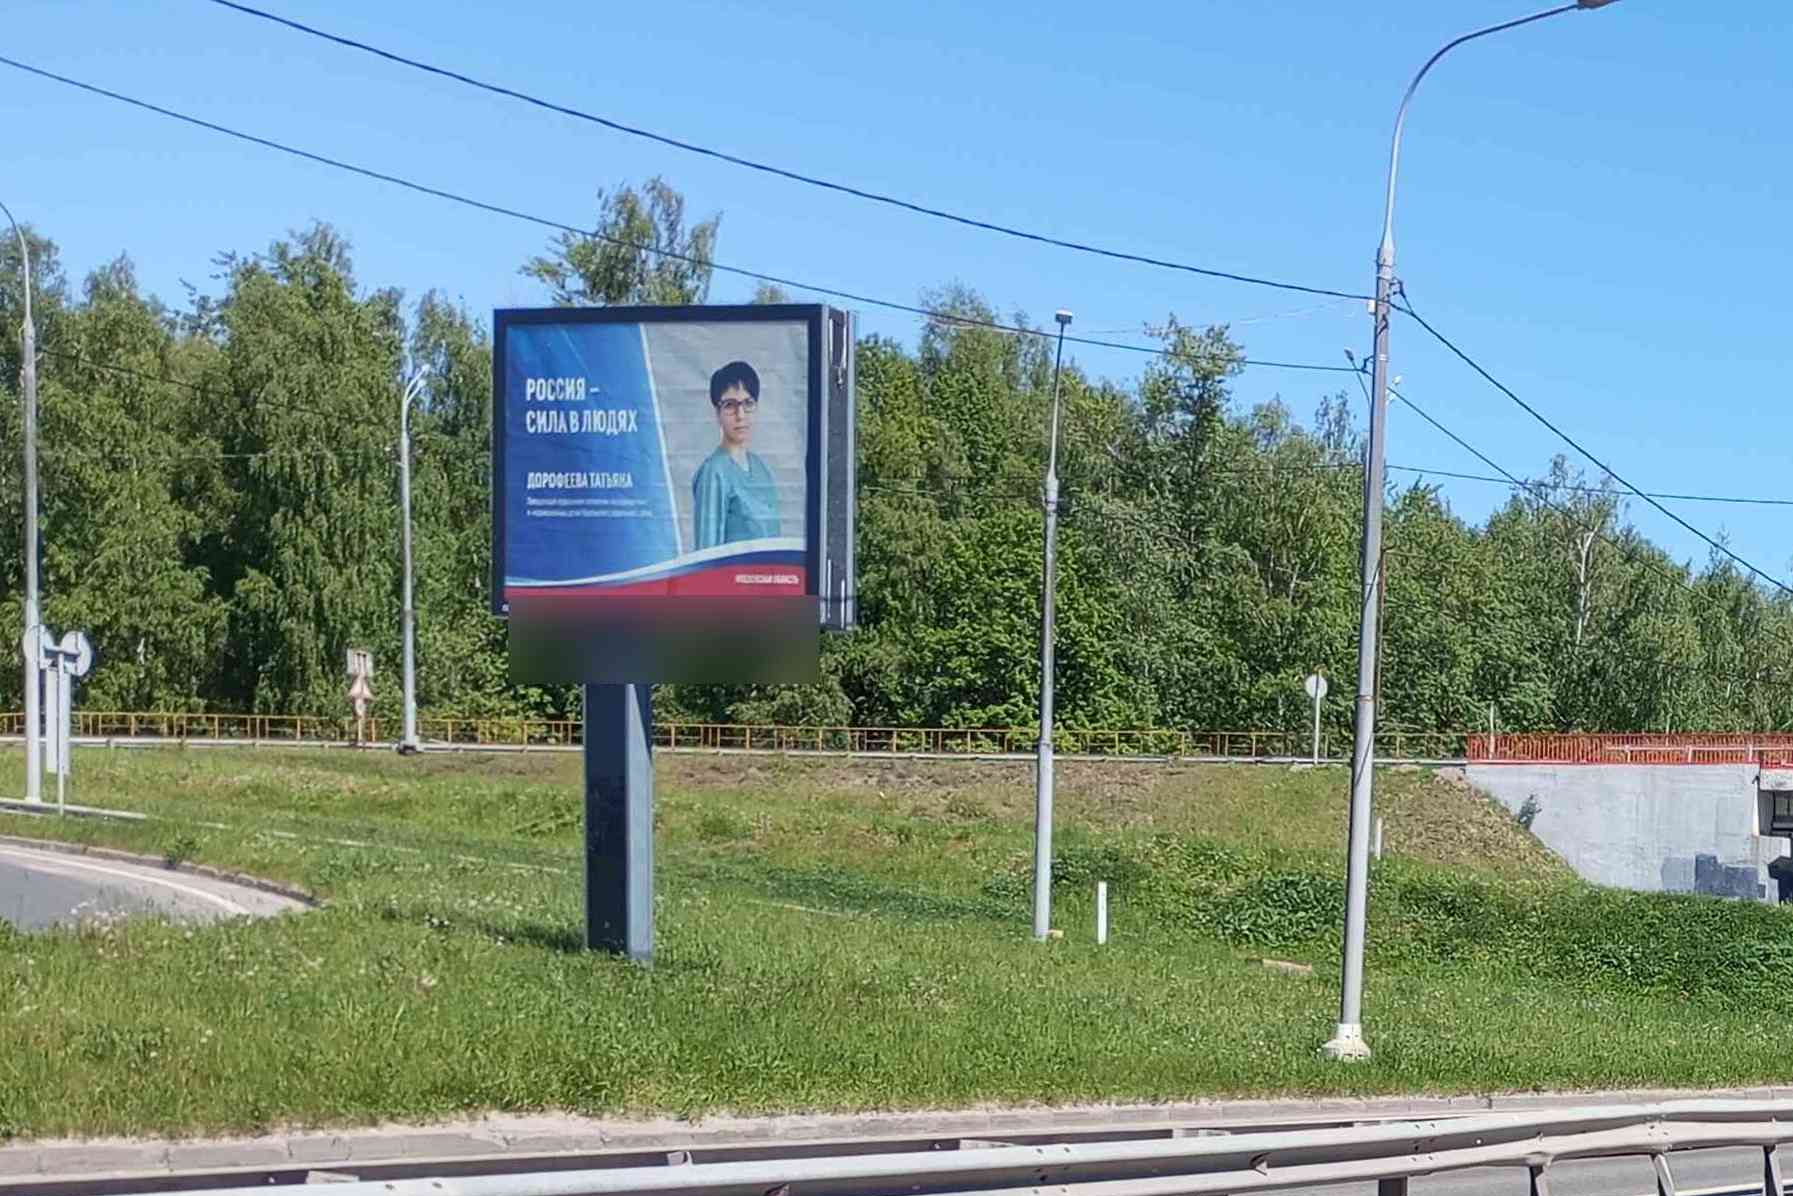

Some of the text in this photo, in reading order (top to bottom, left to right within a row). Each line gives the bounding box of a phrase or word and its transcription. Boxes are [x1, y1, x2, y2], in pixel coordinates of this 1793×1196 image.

[526, 378, 586, 401] РОССИЯ
[527, 409, 638, 435] СИЛА В ЛЮДЯХ
[527, 472, 633, 489] ДОРОФЕЕВА ТАТЬЯНА
